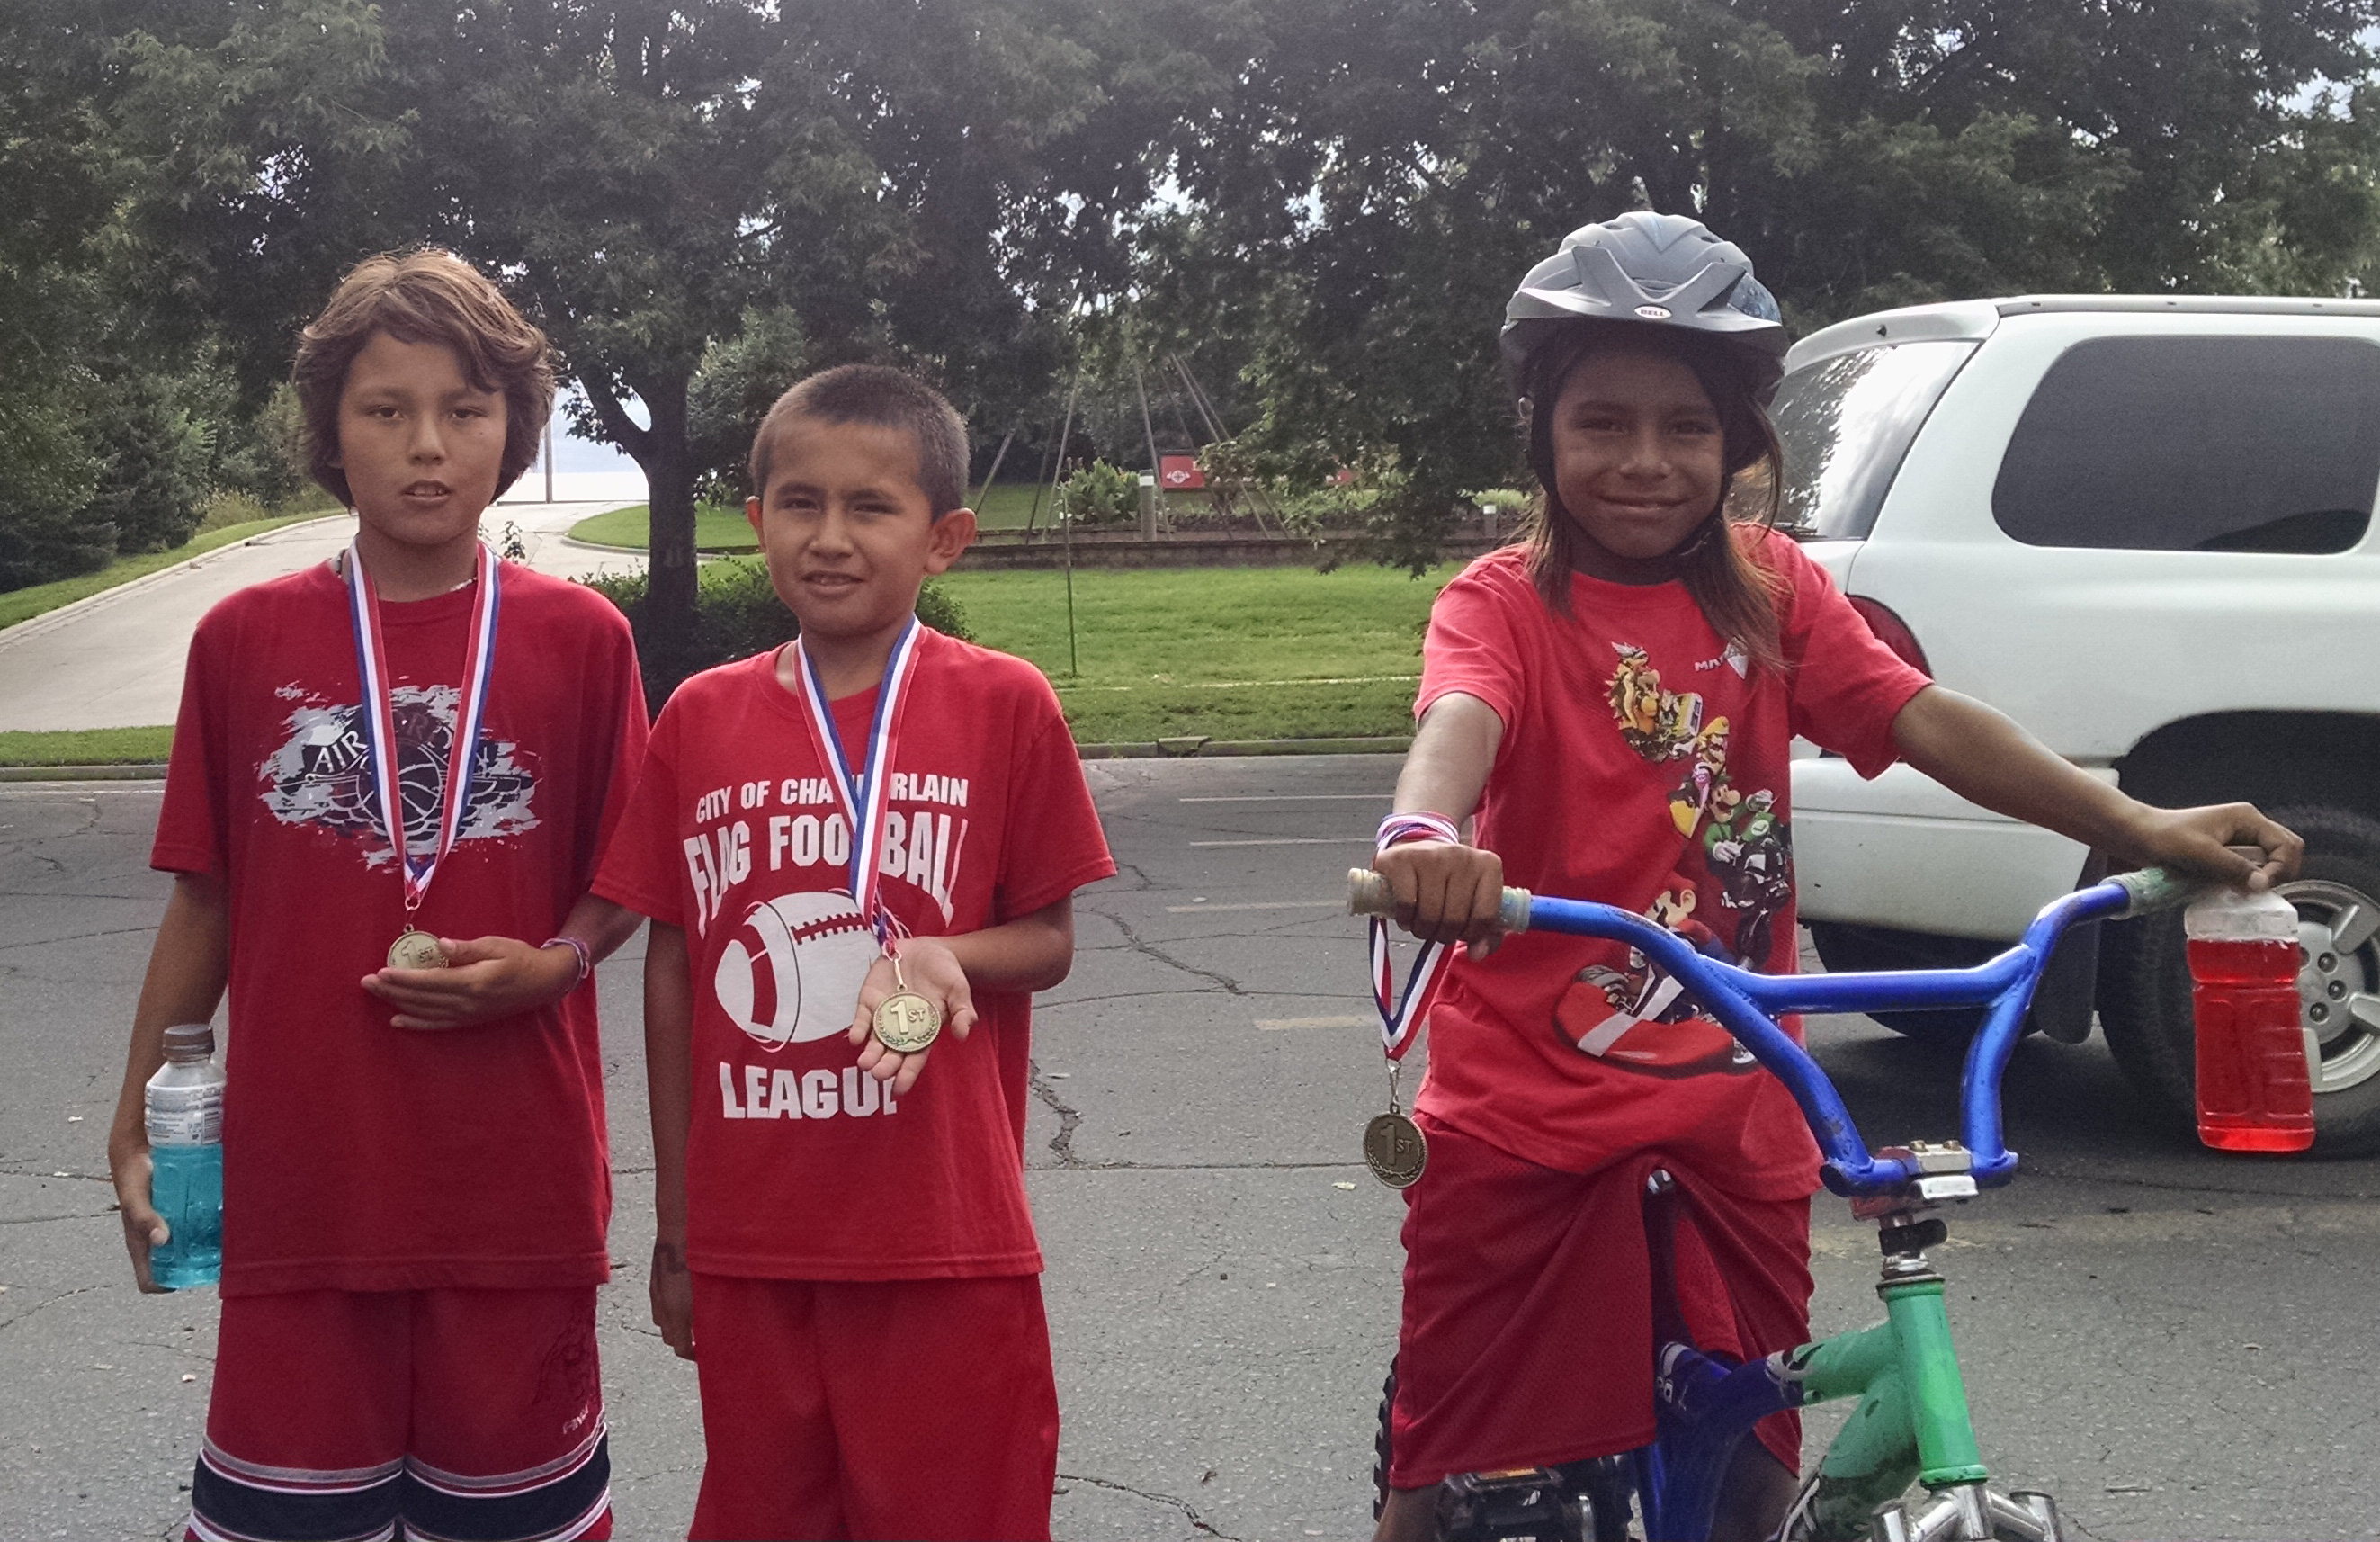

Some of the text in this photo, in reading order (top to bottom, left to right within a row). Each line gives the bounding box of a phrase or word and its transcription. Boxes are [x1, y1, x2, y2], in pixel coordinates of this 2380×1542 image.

[312, 731, 368, 773] AIR
[696, 772, 969, 823] CITY OF CHARLAIN
[683, 811, 969, 940] FLAG FOOBALL
[890, 1000, 926, 1035] 1ST
[1380, 1123, 1413, 1166] 1ST
